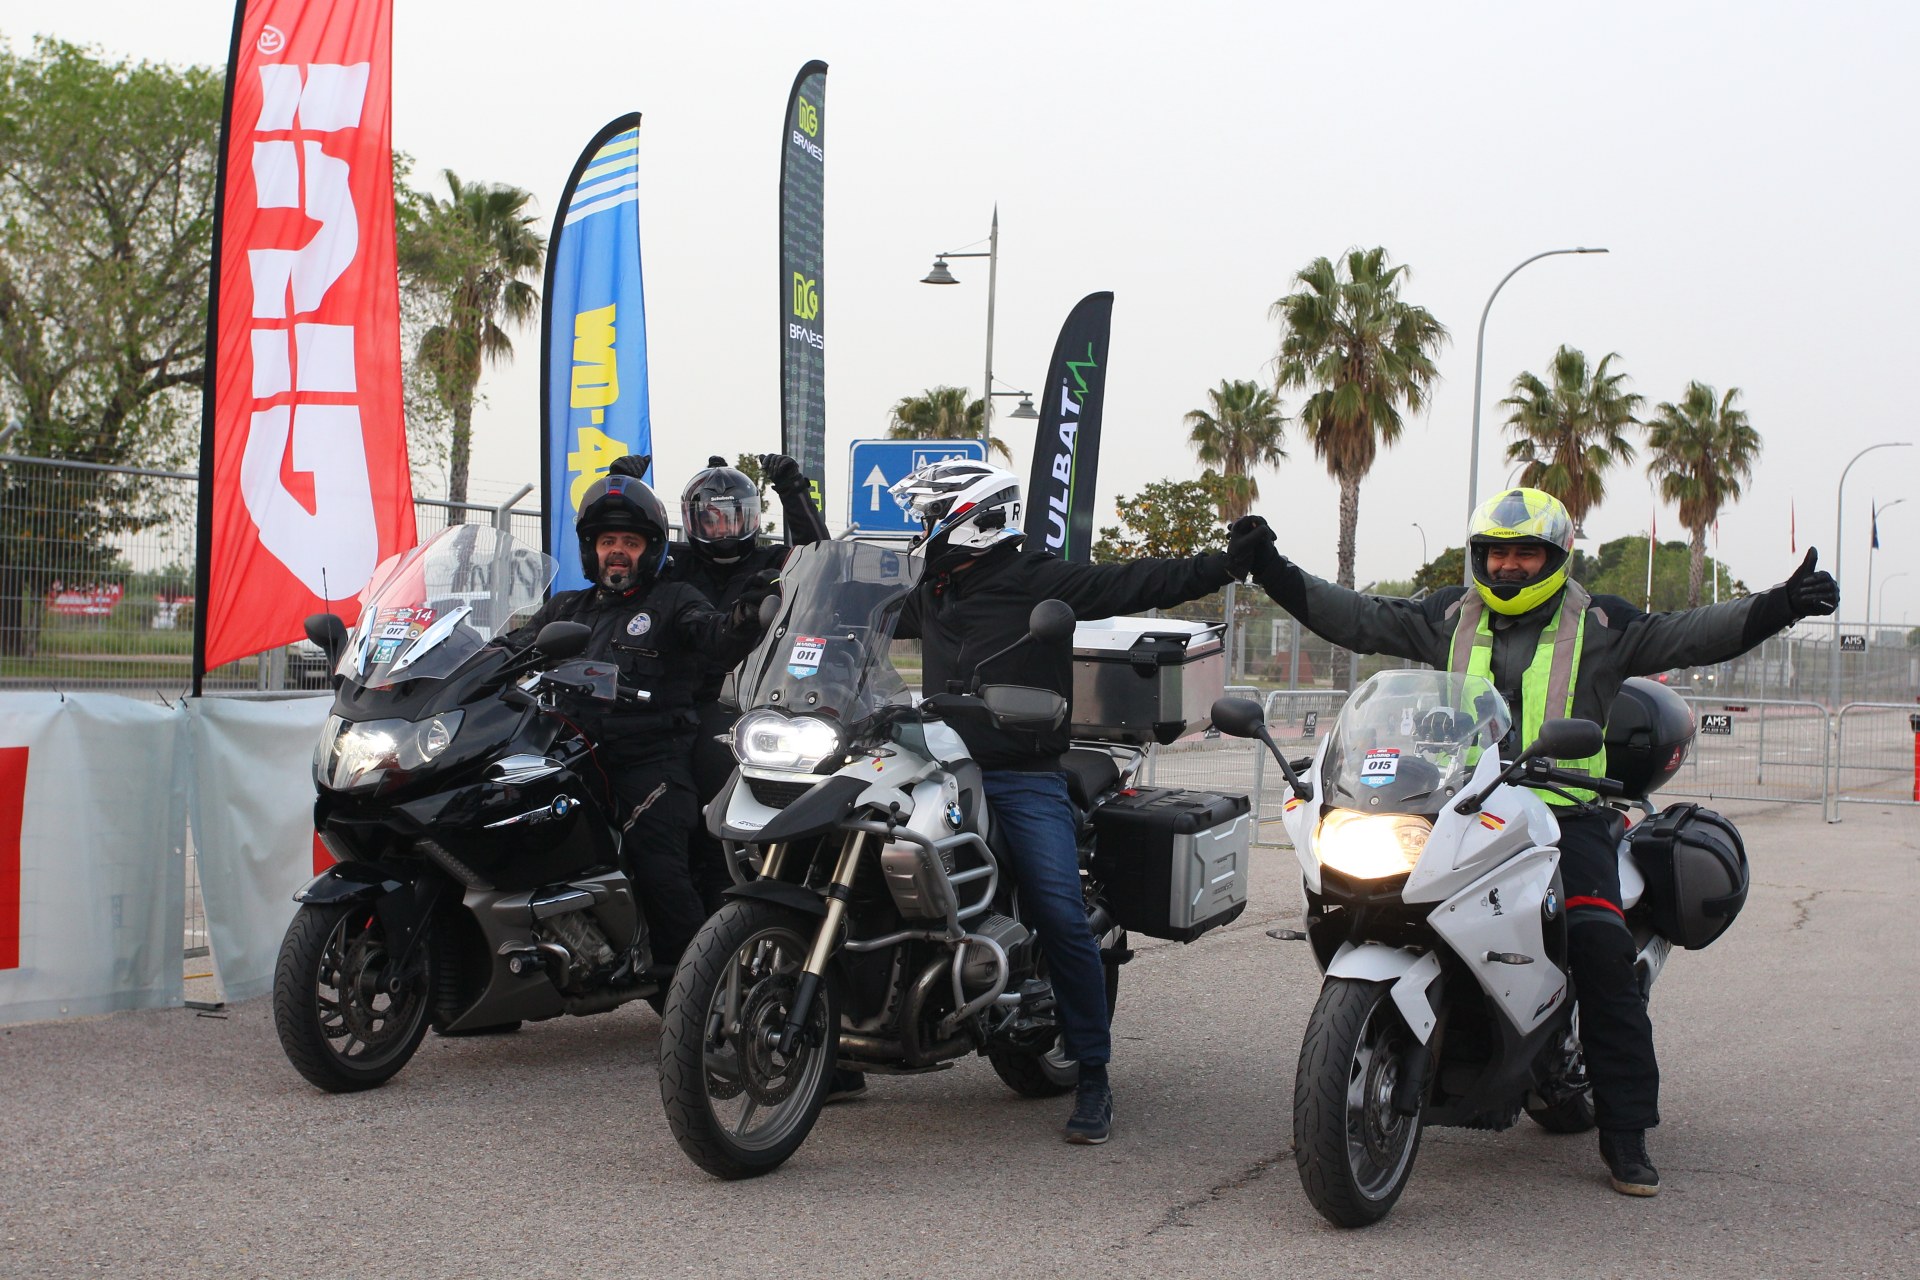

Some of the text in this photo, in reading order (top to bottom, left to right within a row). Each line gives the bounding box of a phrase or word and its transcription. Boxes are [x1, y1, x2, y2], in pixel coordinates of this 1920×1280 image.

[793, 130, 823, 162] BRAKES
[1045, 385, 1081, 556] ULBAT
[414, 608, 433, 622] 14
[386, 627, 405, 636] 017
[1844, 636, 1862, 645] AMS
[797, 650, 816, 660] 011
[1706, 715, 1727, 727] AMS
[1368, 761, 1391, 770] 015
